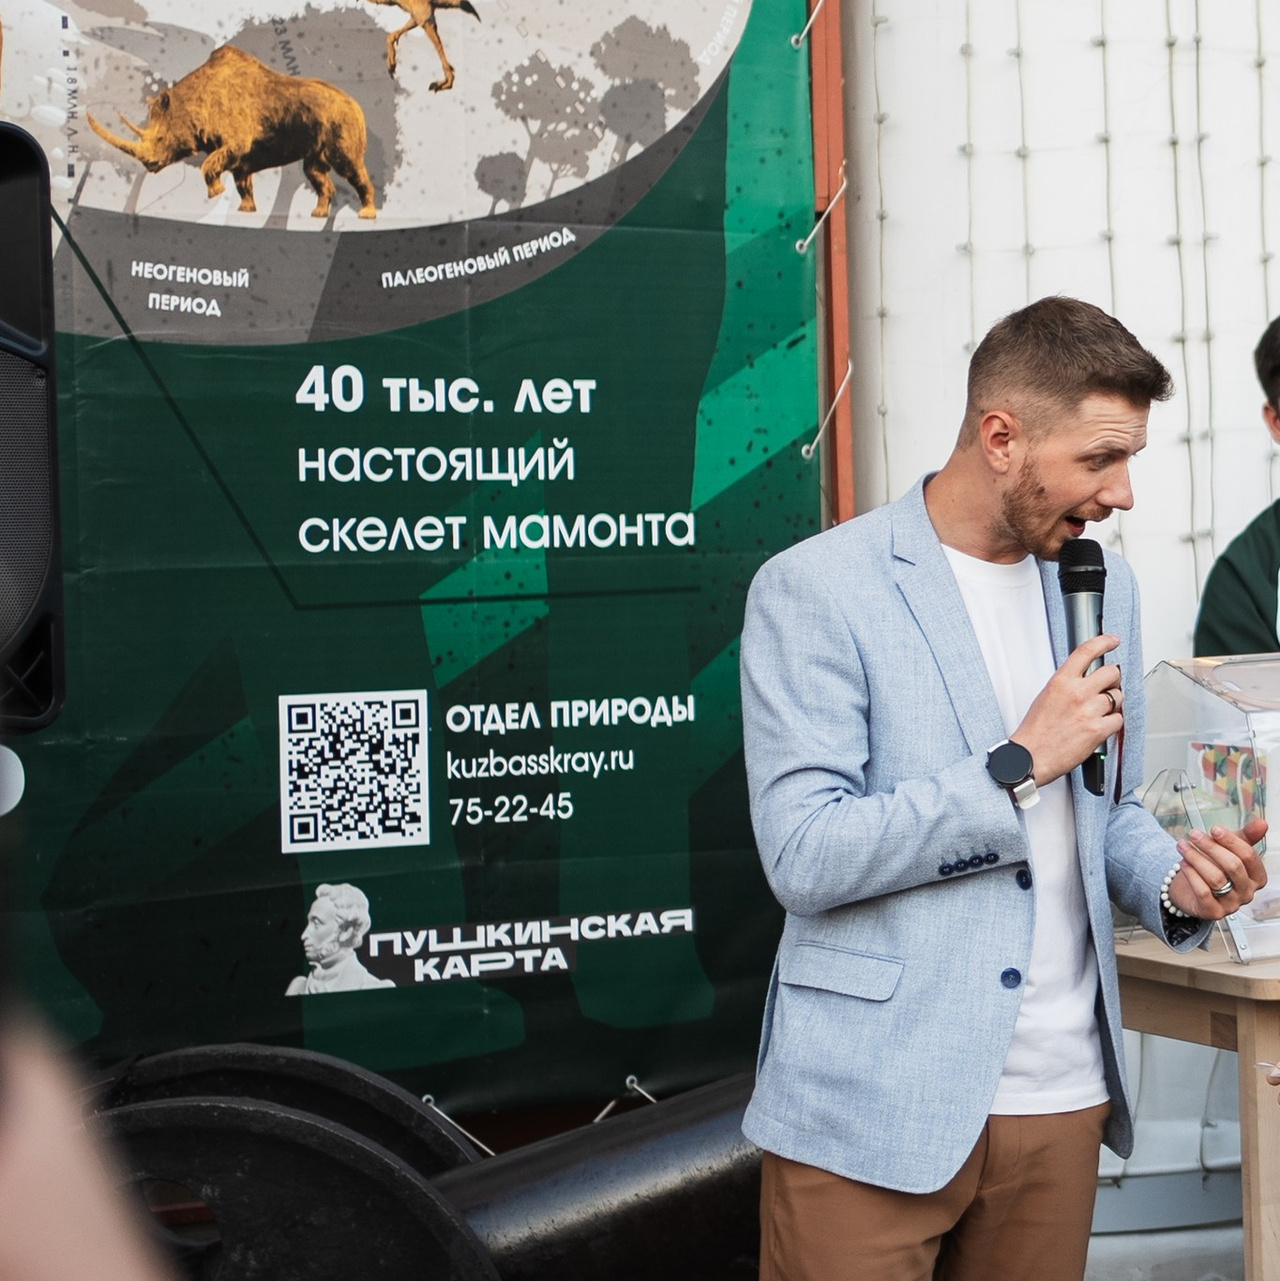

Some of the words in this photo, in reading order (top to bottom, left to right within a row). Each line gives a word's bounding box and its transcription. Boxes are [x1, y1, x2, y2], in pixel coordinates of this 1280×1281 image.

[701, 4, 738, 67] ПЕРИОД
[131, 261, 250, 288] НЕОГЕНОВЫЙ
[381, 247, 510, 289] ПАЛЕОГЕНОВЫЙ
[512, 227, 576, 263] ПЕРИОД
[148, 292, 221, 318] ПЕРИОД
[295, 365, 364, 414] 40
[382, 375, 494, 414] тыс.
[514, 377, 597, 415] лет
[298, 437, 576, 486] настоящий
[298, 515, 467, 554] скелет
[483, 509, 695, 551] мамонта
[446, 701, 541, 736] ОТДЕЛ
[551, 695, 695, 729] ПРИРОДЫ
[446, 746, 635, 782] kuzbasskray.ru
[449, 793, 574, 826] 75-22-45
[369, 908, 694, 958] ПУШКИНСКАЯ
[413, 947, 568, 982] КАРТА
